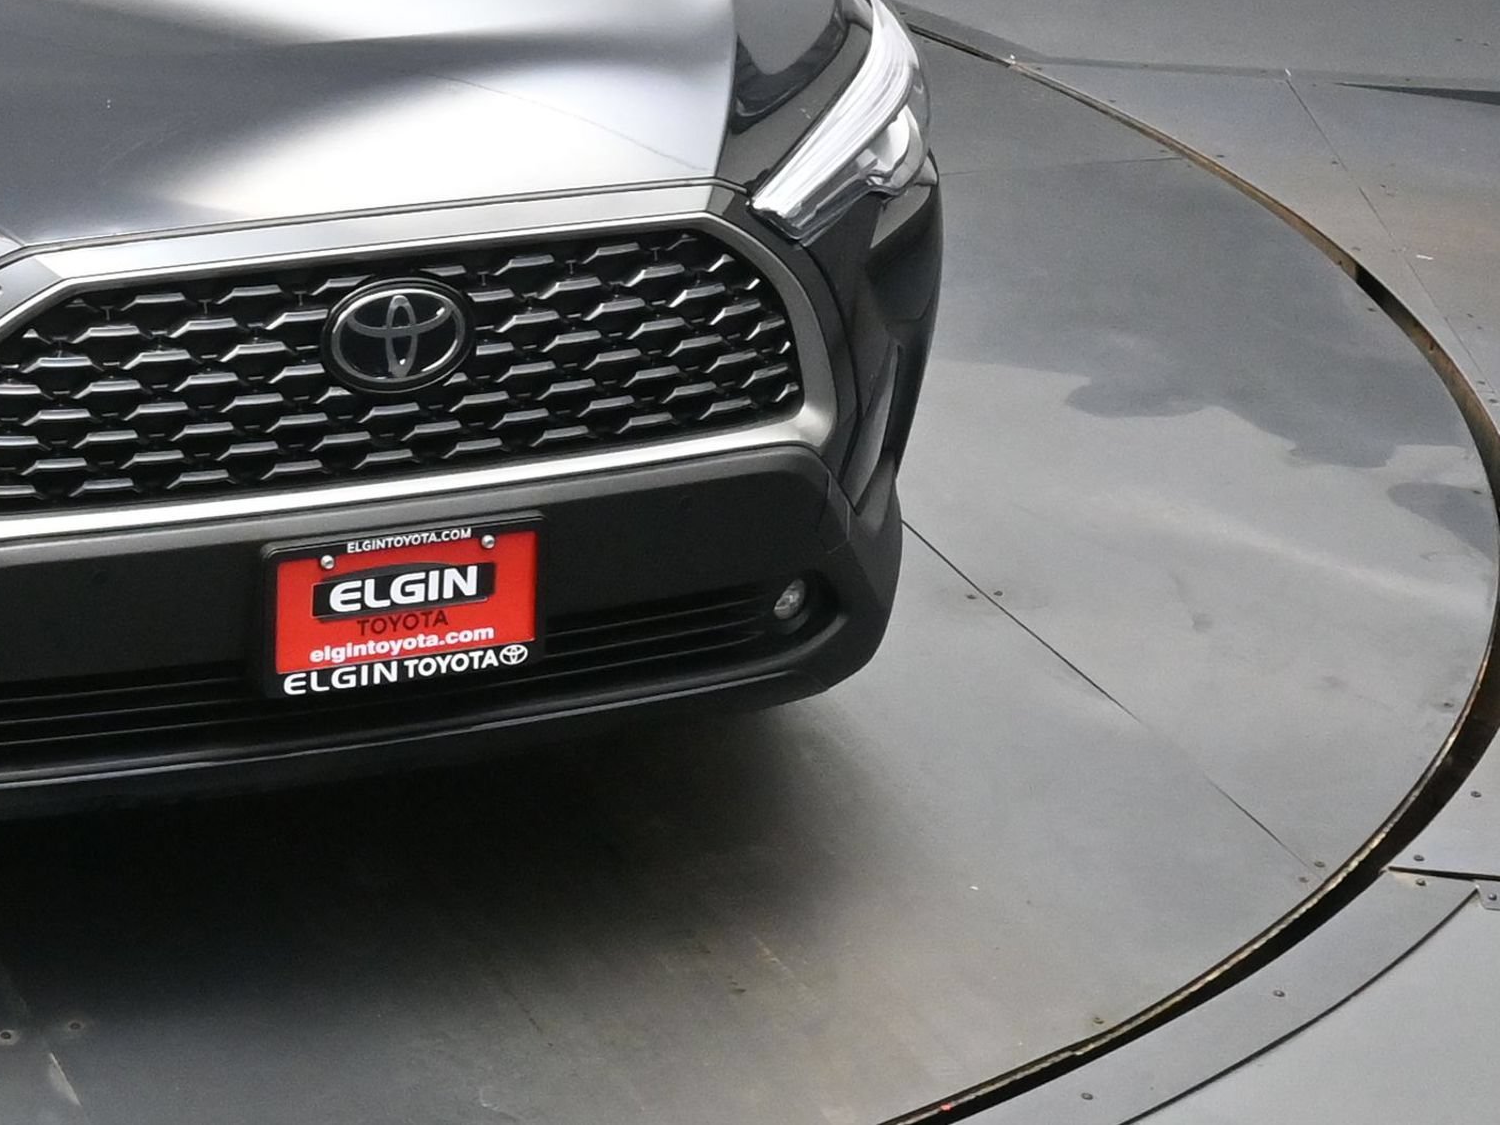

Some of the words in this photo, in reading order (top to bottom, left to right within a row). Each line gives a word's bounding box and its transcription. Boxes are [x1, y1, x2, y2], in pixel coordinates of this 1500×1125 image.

[347, 528, 472, 554] ELGINTOYOTA.COM
[329, 565, 478, 612] ELGIN
[357, 610, 448, 636] TOYOTA
[310, 626, 494, 663] elgintoyota.com
[283, 660, 398, 695] ELGIN
[404, 650, 499, 678] TOYOTA
